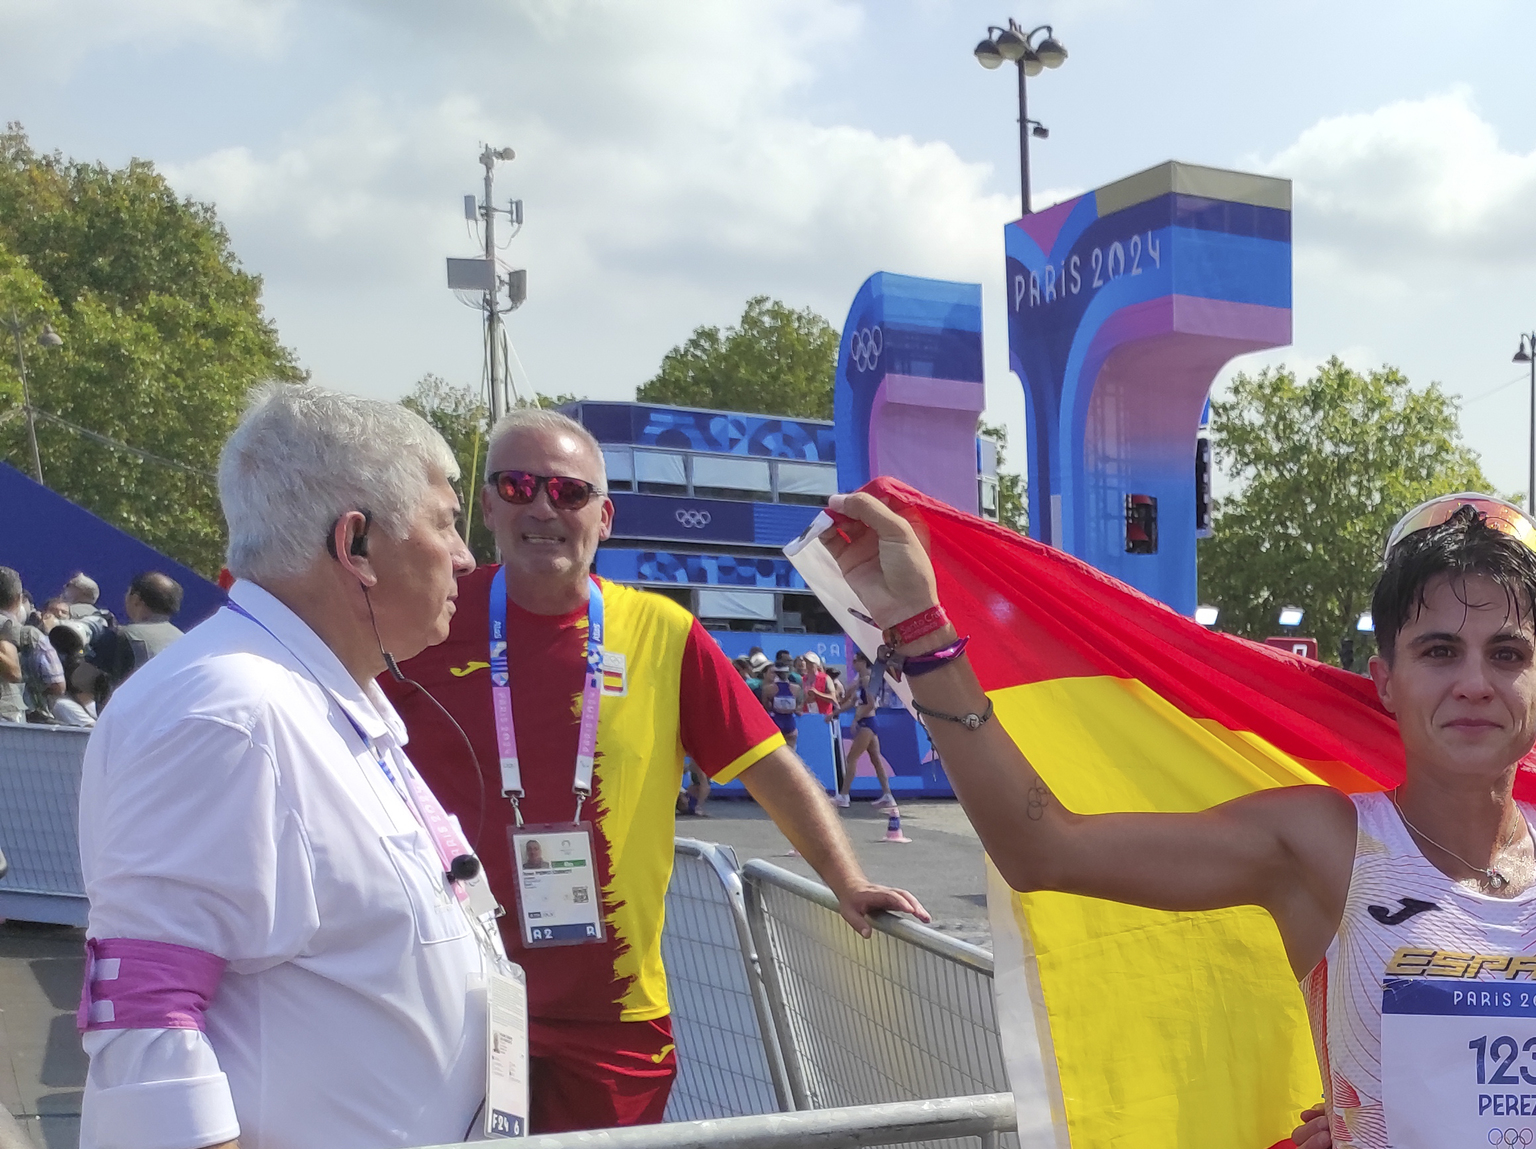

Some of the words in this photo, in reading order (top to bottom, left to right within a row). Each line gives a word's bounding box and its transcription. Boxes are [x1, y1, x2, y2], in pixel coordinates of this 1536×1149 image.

[1092, 230, 1160, 288] 2024
[817, 643, 840, 657] PA
[437, 826, 460, 856] ARIS
